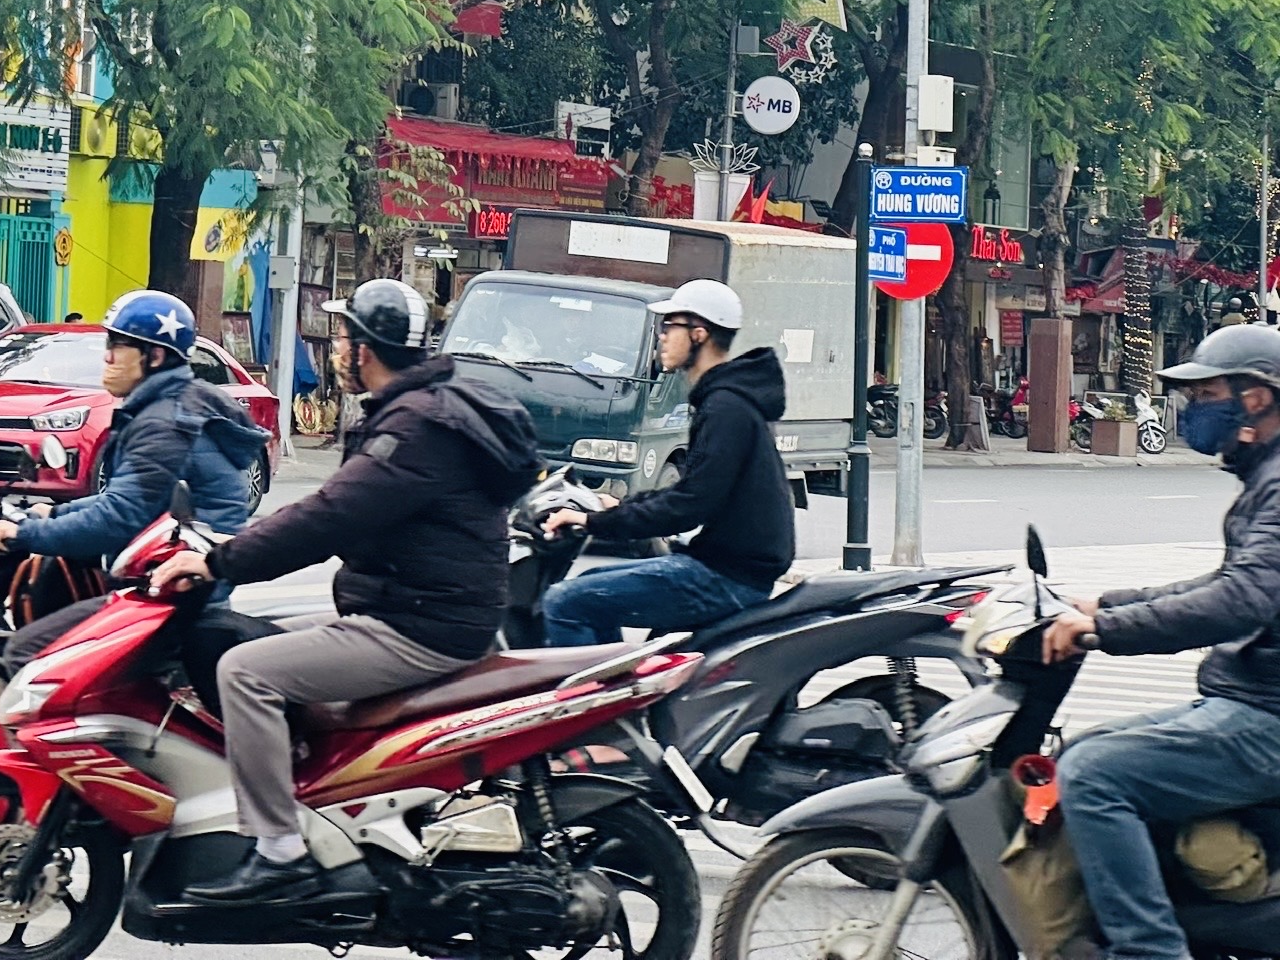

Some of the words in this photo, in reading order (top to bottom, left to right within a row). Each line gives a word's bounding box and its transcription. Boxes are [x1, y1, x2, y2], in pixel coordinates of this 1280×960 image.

[767, 98, 792, 114] MB
[900, 173, 953, 187] ĐƯỜNG
[877, 189, 913, 213] HÙNG
[916, 193, 960, 214] VƯƠNG
[882, 233, 897, 246] PHỐ
